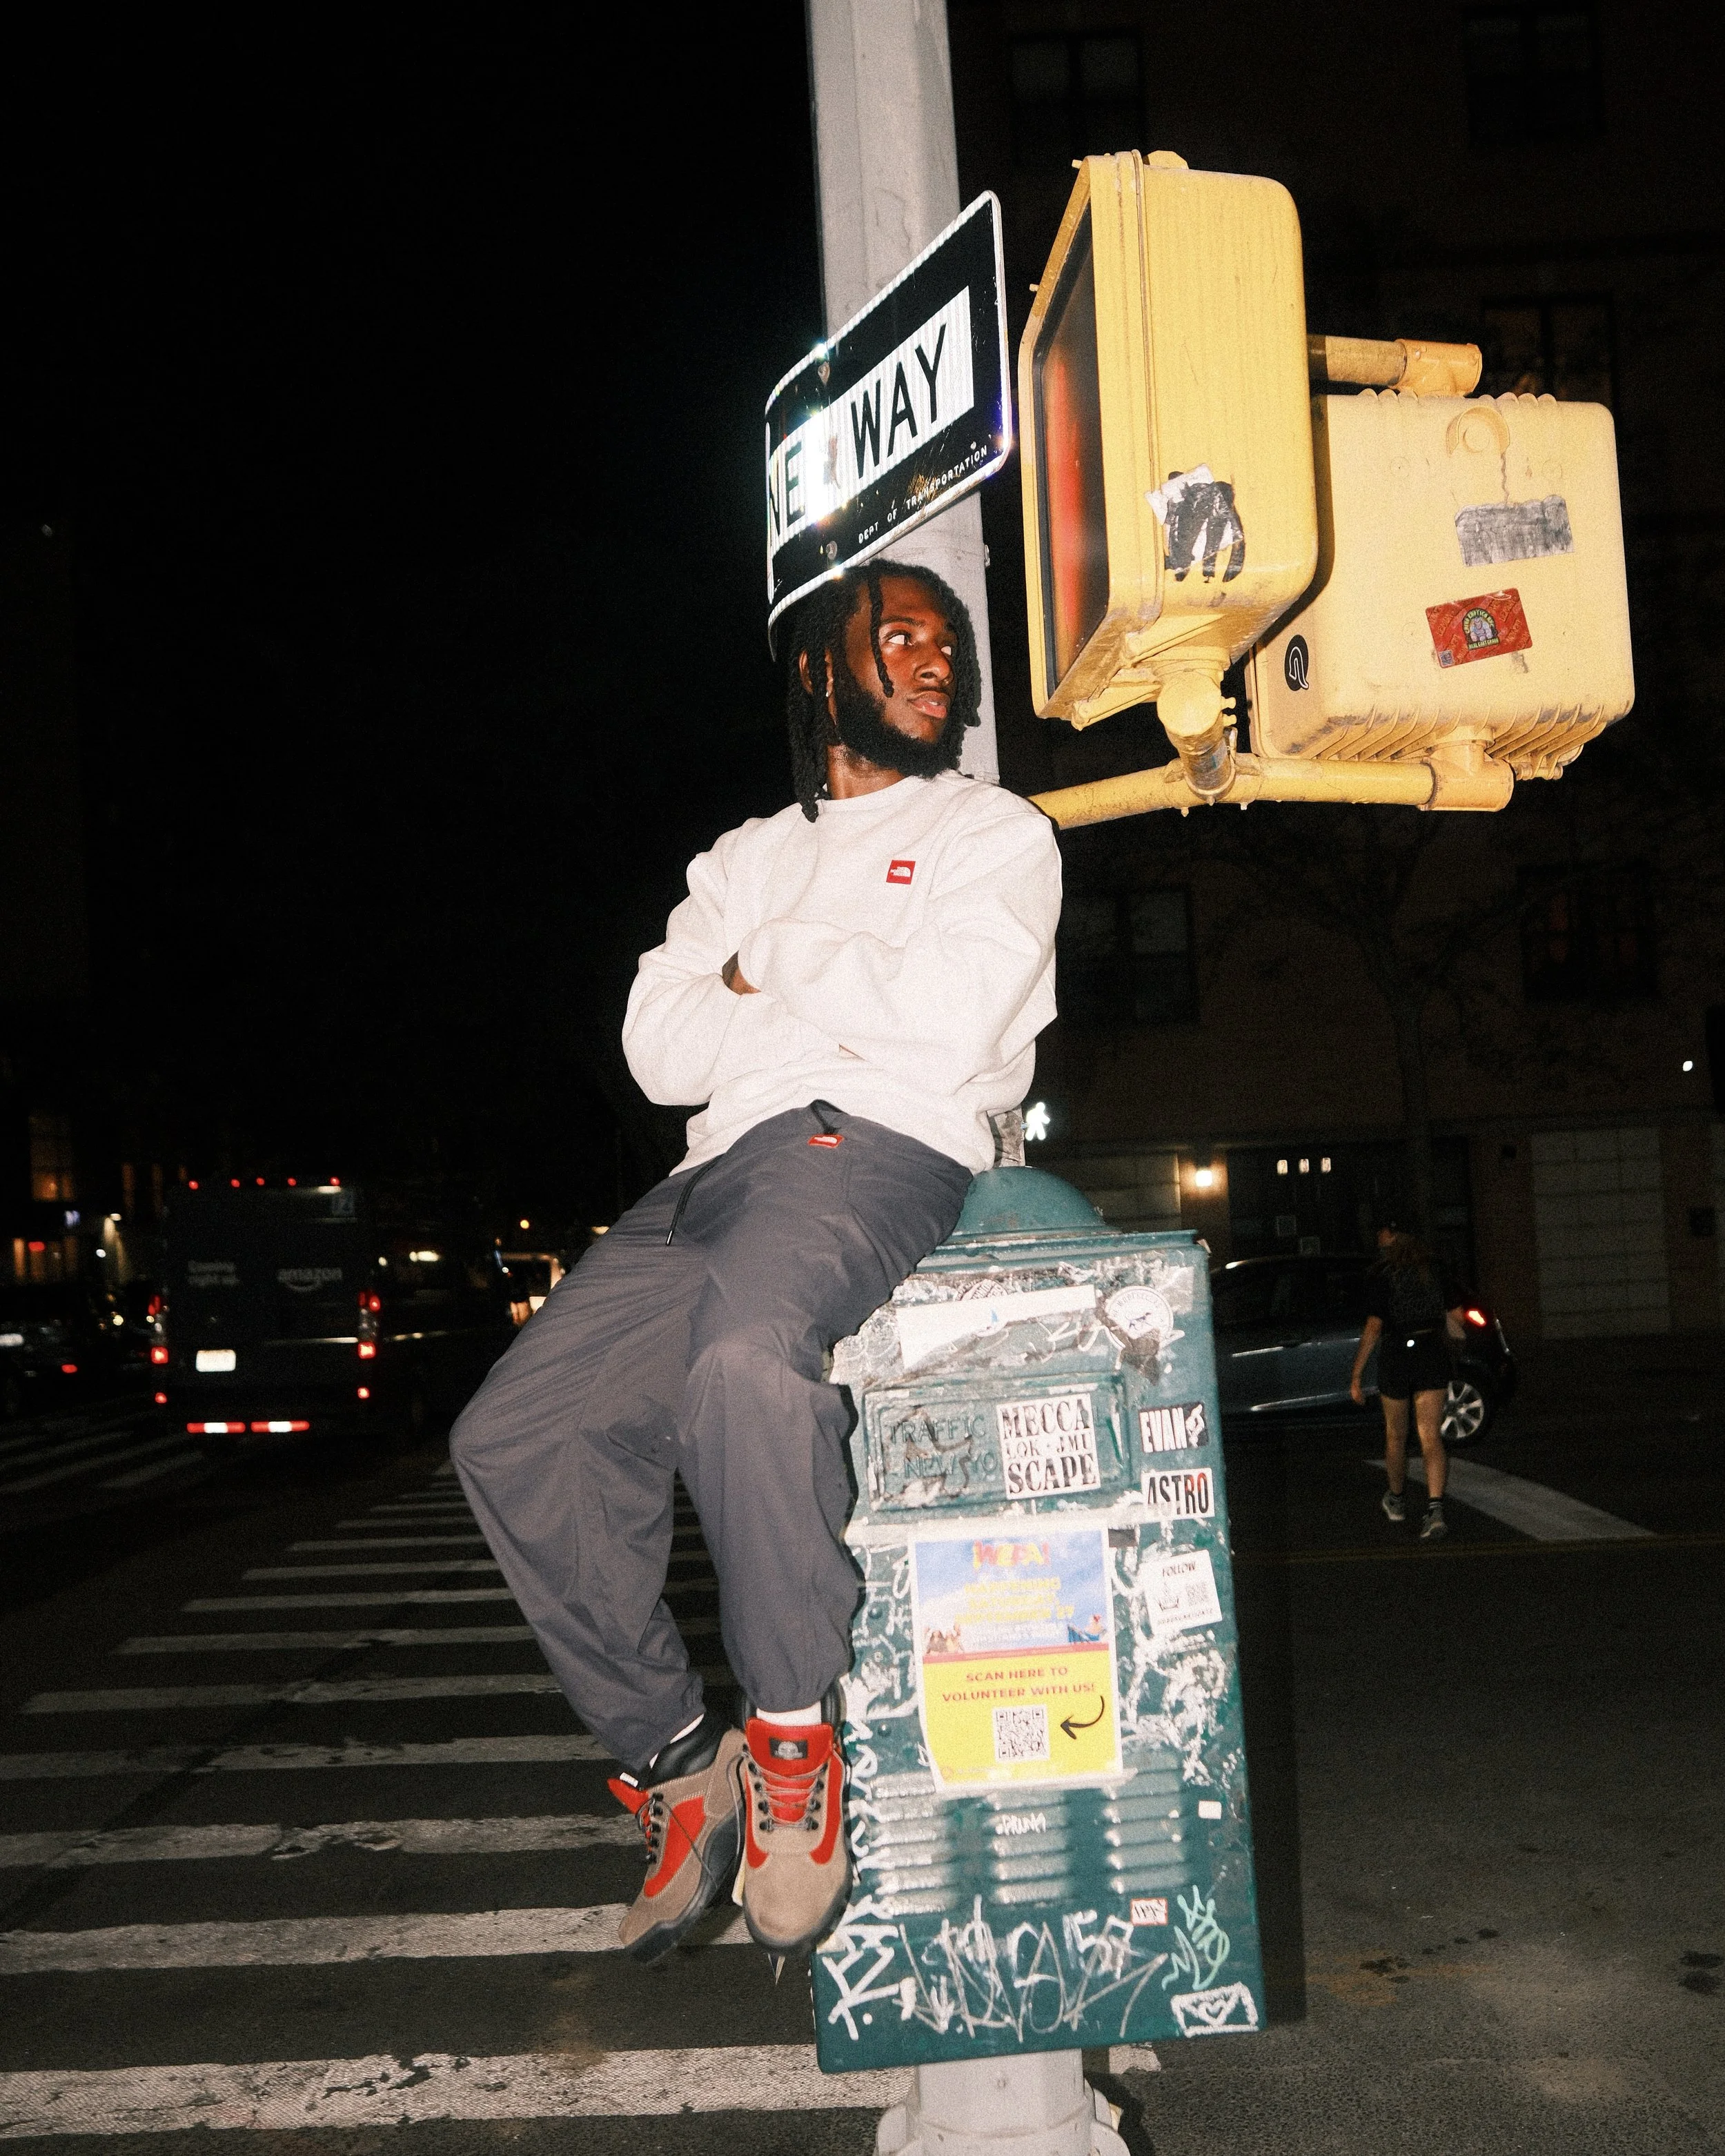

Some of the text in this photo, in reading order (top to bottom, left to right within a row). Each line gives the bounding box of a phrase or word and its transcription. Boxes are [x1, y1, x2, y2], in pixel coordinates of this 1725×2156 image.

[769, 324, 947, 548] NE WAY
[858, 445, 987, 544] DEPT OF TRANSPORTATION
[885, 1414, 985, 1444] TRAFFIC
[1002, 1399, 1090, 1439] MECCA
[1140, 1407, 1187, 1453] EVAN
[905, 1452, 955, 1478] NEW
[1008, 1453, 1096, 1494] SCAPE
[1147, 1472, 1210, 1515] ASTRO
[1162, 1561, 1196, 1577] FOLLOW
[943, 1683, 1095, 1701] VOLUNTEER WITH US!
[966, 1666, 1068, 1681] SCAN HERE TO
